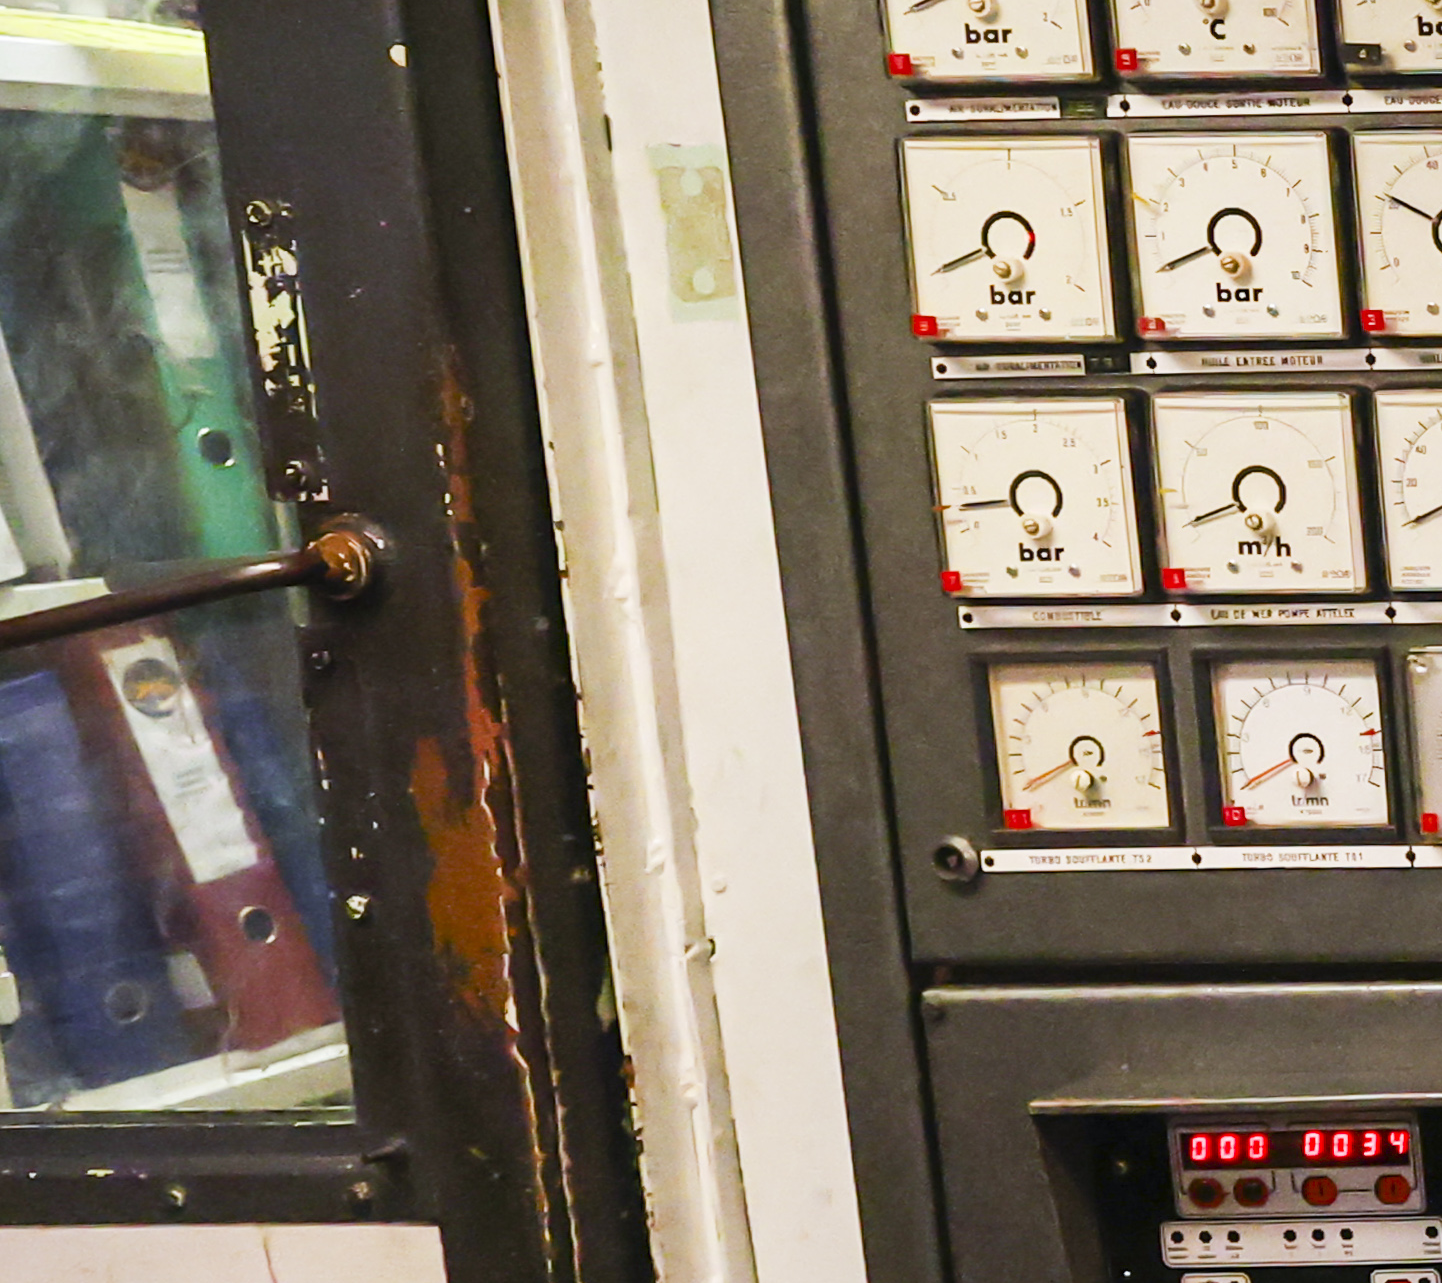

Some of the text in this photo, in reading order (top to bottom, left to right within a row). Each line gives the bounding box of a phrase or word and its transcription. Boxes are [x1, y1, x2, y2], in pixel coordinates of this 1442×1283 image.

[965, 23, 1012, 43] bar
[1202, 18, 1226, 40] °C
[989, 284, 1036, 305] bar
[1216, 282, 1264, 302] bar
[1019, 542, 1065, 562] bar
[1191, 1132, 1409, 1160] 000 0034
